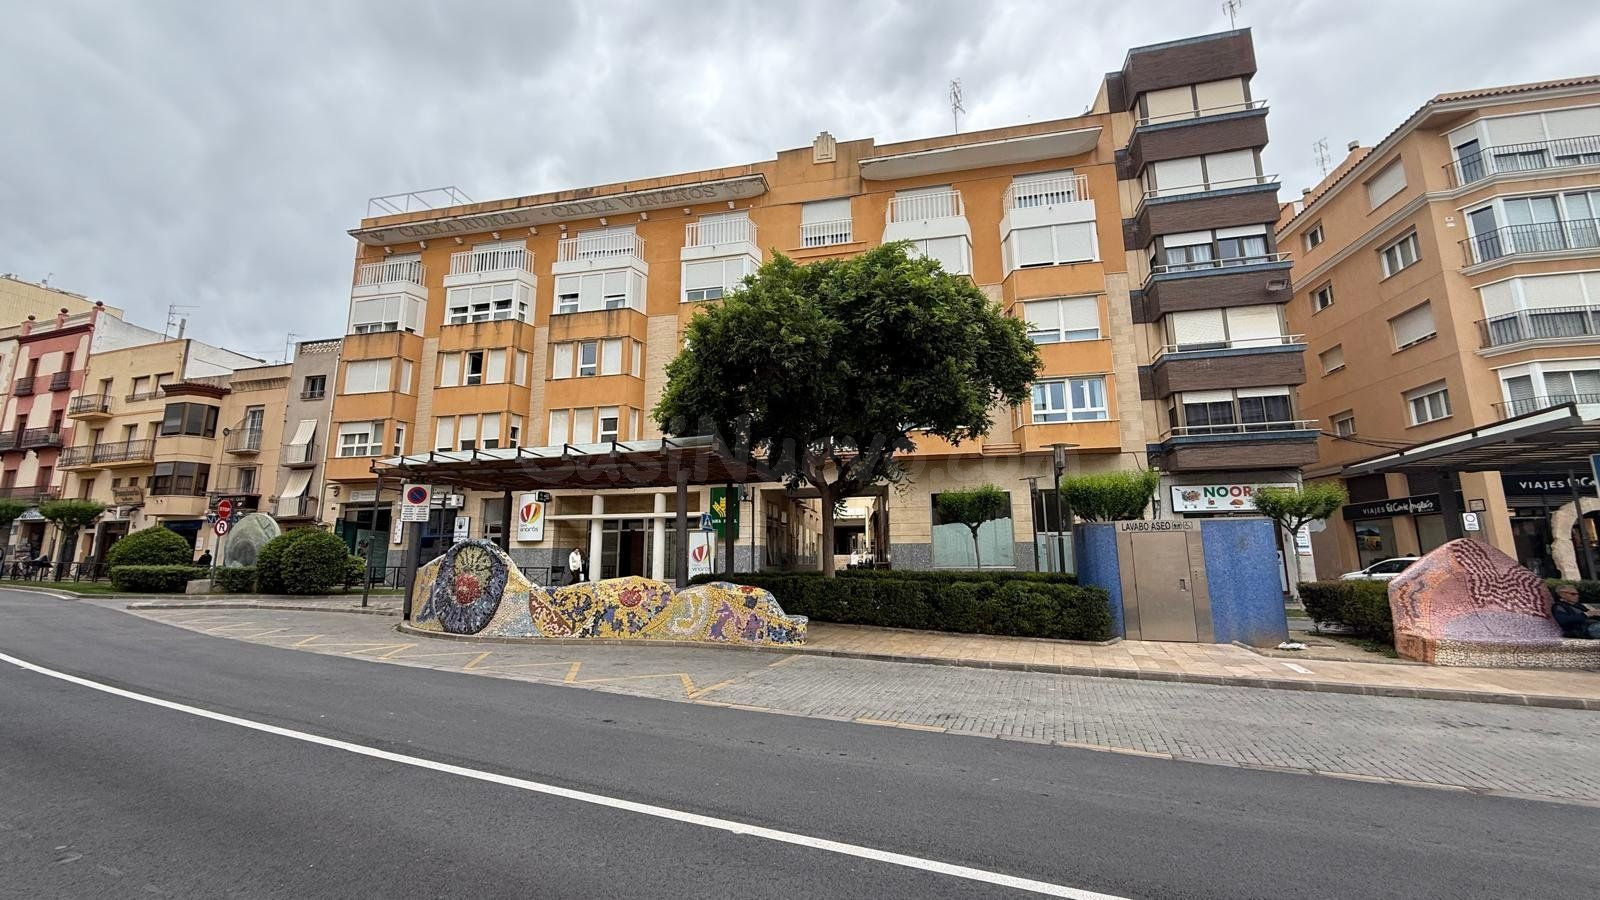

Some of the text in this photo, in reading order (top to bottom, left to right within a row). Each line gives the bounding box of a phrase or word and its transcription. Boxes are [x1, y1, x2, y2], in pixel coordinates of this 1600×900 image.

[401, 220, 460, 239] CAIXA
[459, 212, 530, 232] RURAL
[551, 200, 619, 218] CAIXA
[1519, 480, 1565, 490] VIAJES
[1203, 486, 1252, 498] NOOR
[1362, 506, 1386, 516] VIAJES
[1121, 521, 1171, 532] LAVABO ASEO
